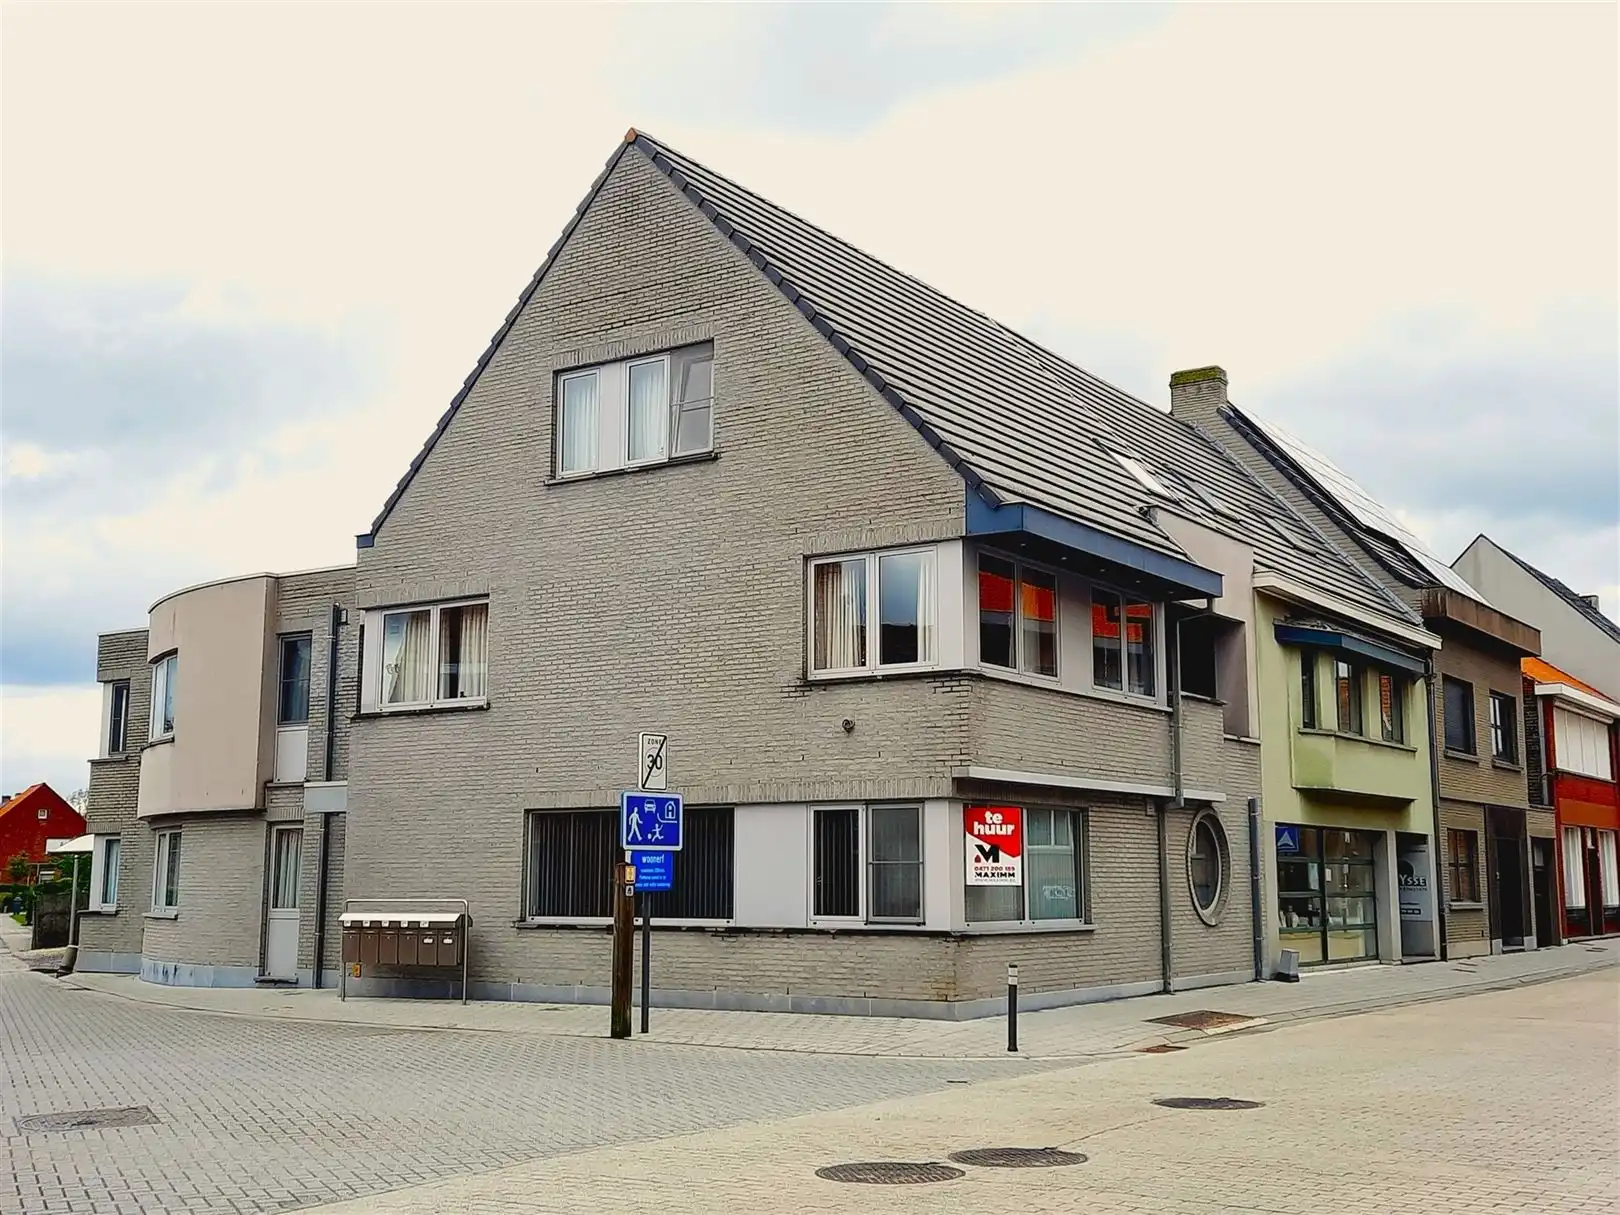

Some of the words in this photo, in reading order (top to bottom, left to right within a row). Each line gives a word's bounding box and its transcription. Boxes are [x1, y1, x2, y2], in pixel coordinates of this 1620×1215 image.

[647, 753, 663, 770] 30
[984, 810, 1004, 825] te
[973, 820, 1016, 836] huur
[641, 853, 665, 864] woonerf
